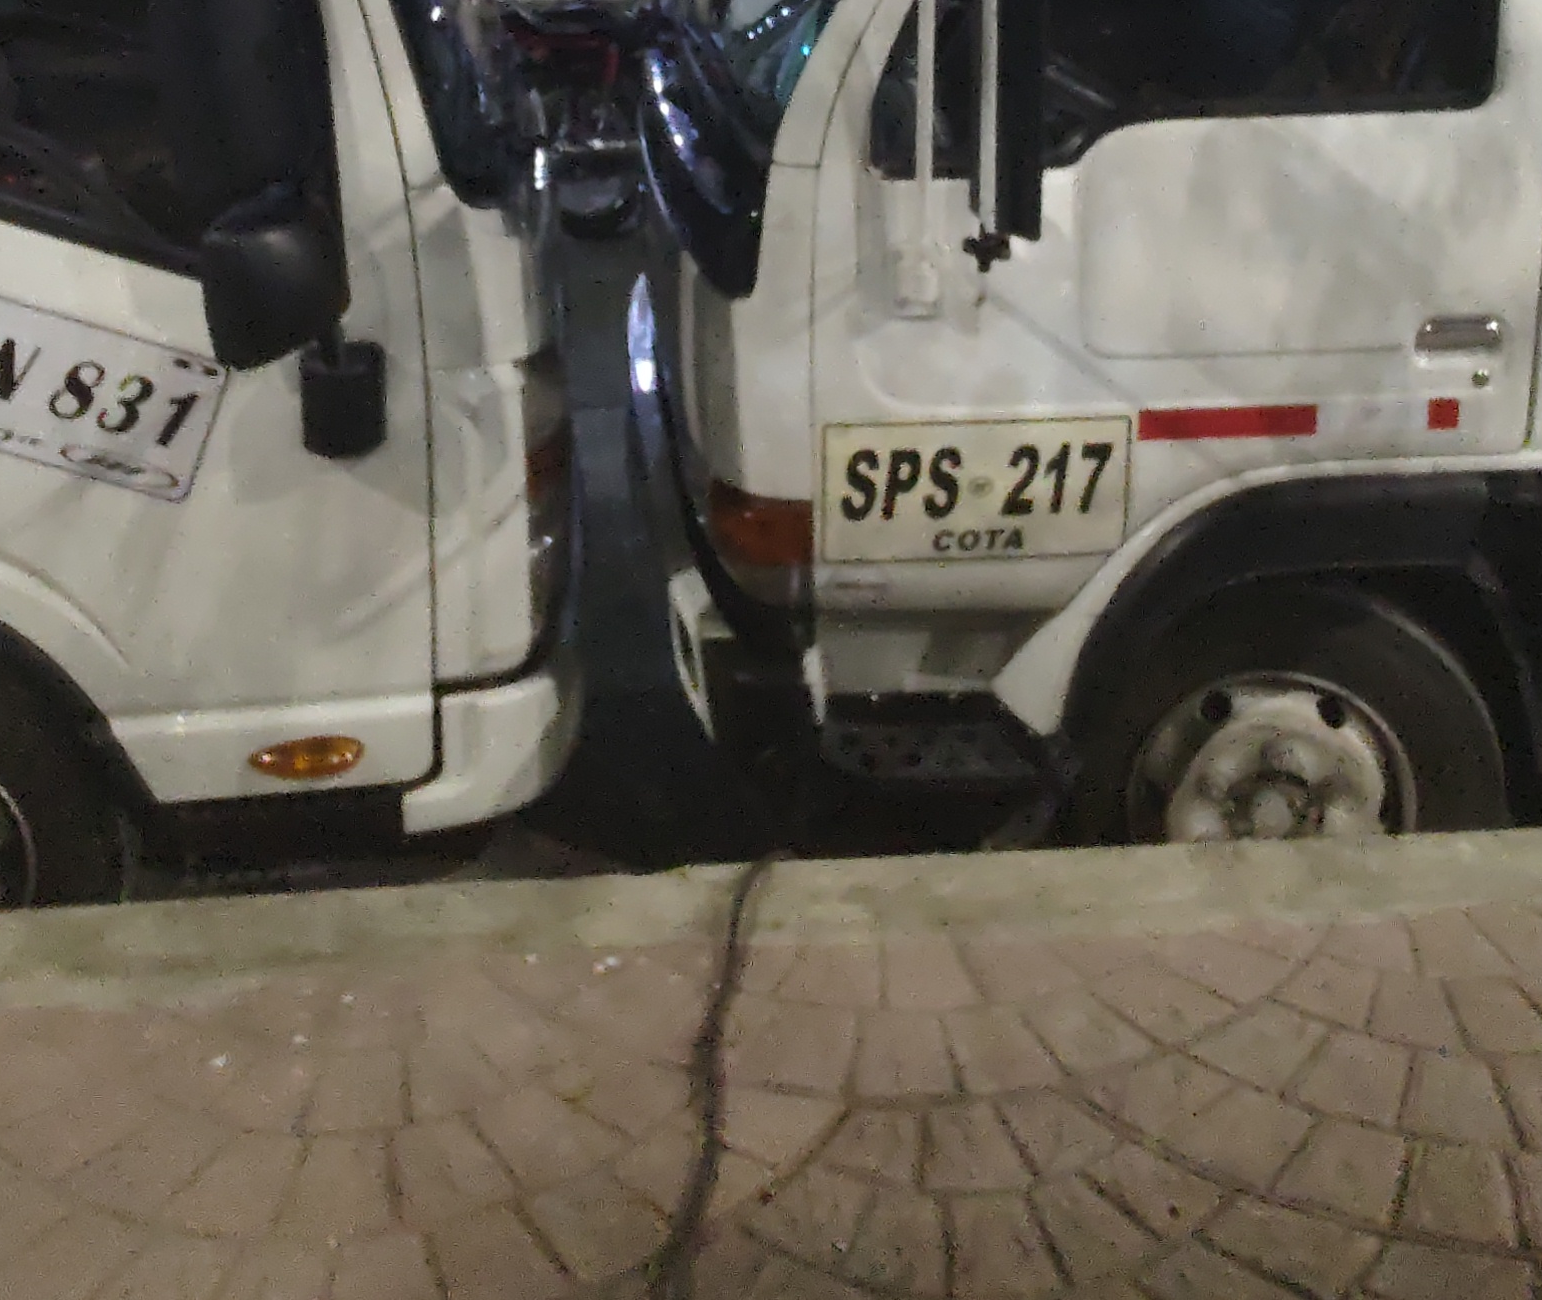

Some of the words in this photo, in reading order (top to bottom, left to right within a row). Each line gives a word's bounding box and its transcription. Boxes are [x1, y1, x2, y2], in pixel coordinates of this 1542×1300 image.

[47, 359, 202, 448] 831
[840, 446, 962, 521] SPS
[1000, 441, 1114, 517] 217
[932, 526, 1025, 552] COTA
